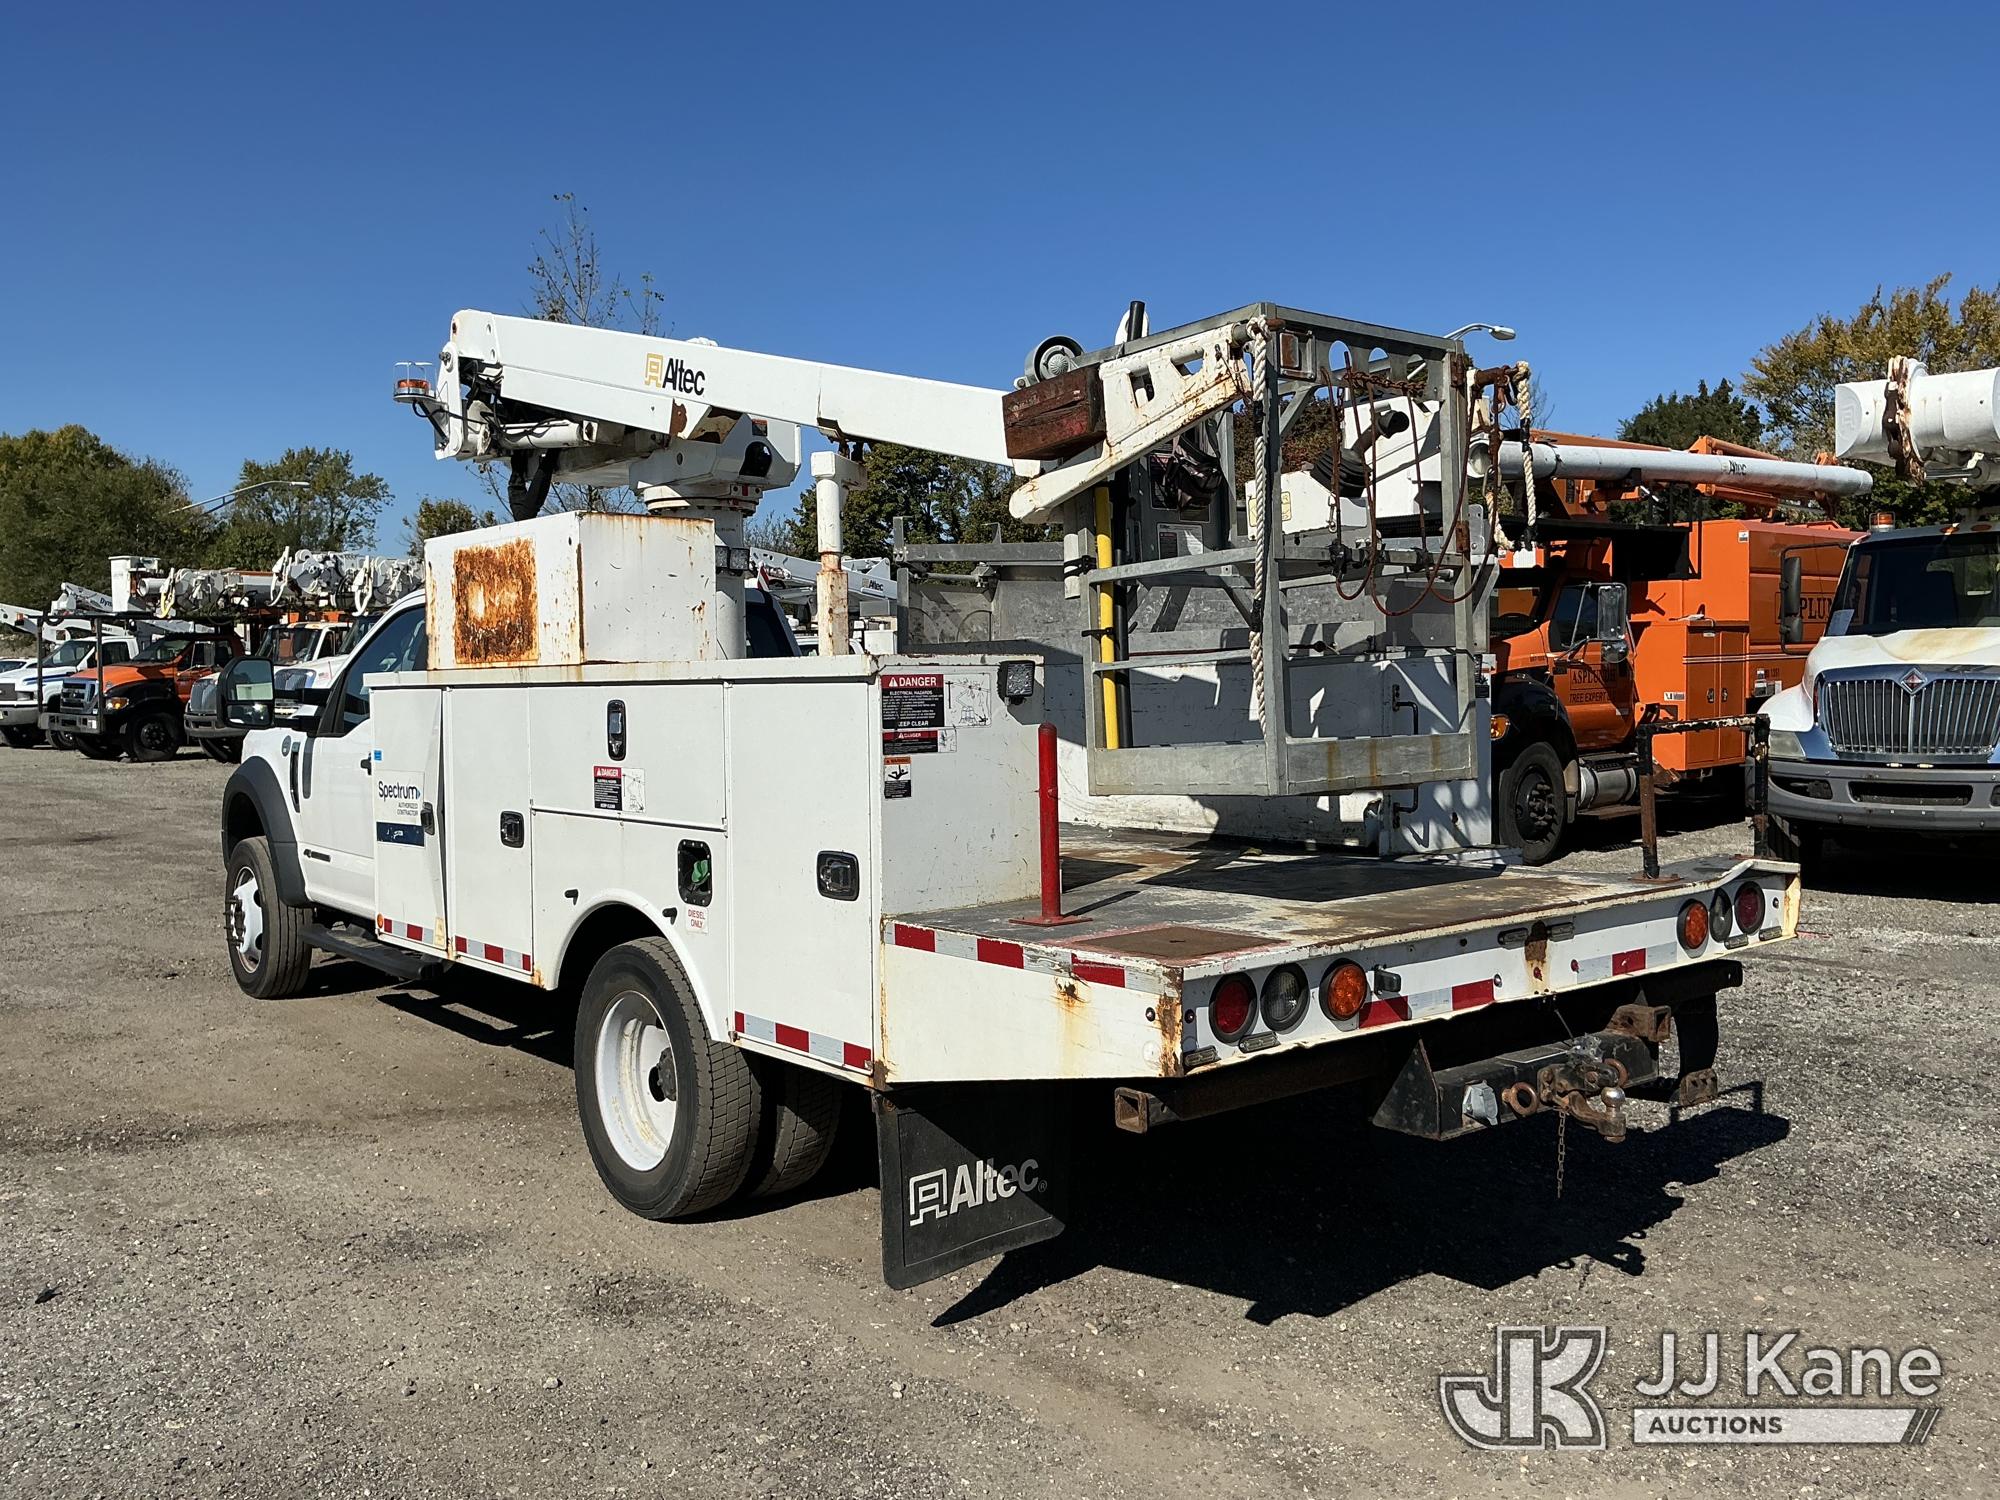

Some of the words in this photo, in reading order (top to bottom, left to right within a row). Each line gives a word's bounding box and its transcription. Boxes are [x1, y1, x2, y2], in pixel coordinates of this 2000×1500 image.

[662, 357, 706, 396] Altec
[899, 676, 937, 687] DANGER
[1569, 692, 1584, 703] TREE
[1585, 691, 1607, 702] EXPERT
[600, 768, 619, 777] DANGER
[378, 780, 419, 802] Spectrum
[688, 909, 705, 920] DIESEL
[691, 919, 703, 928] ONLY
[950, 1158, 1039, 1214] Altec
